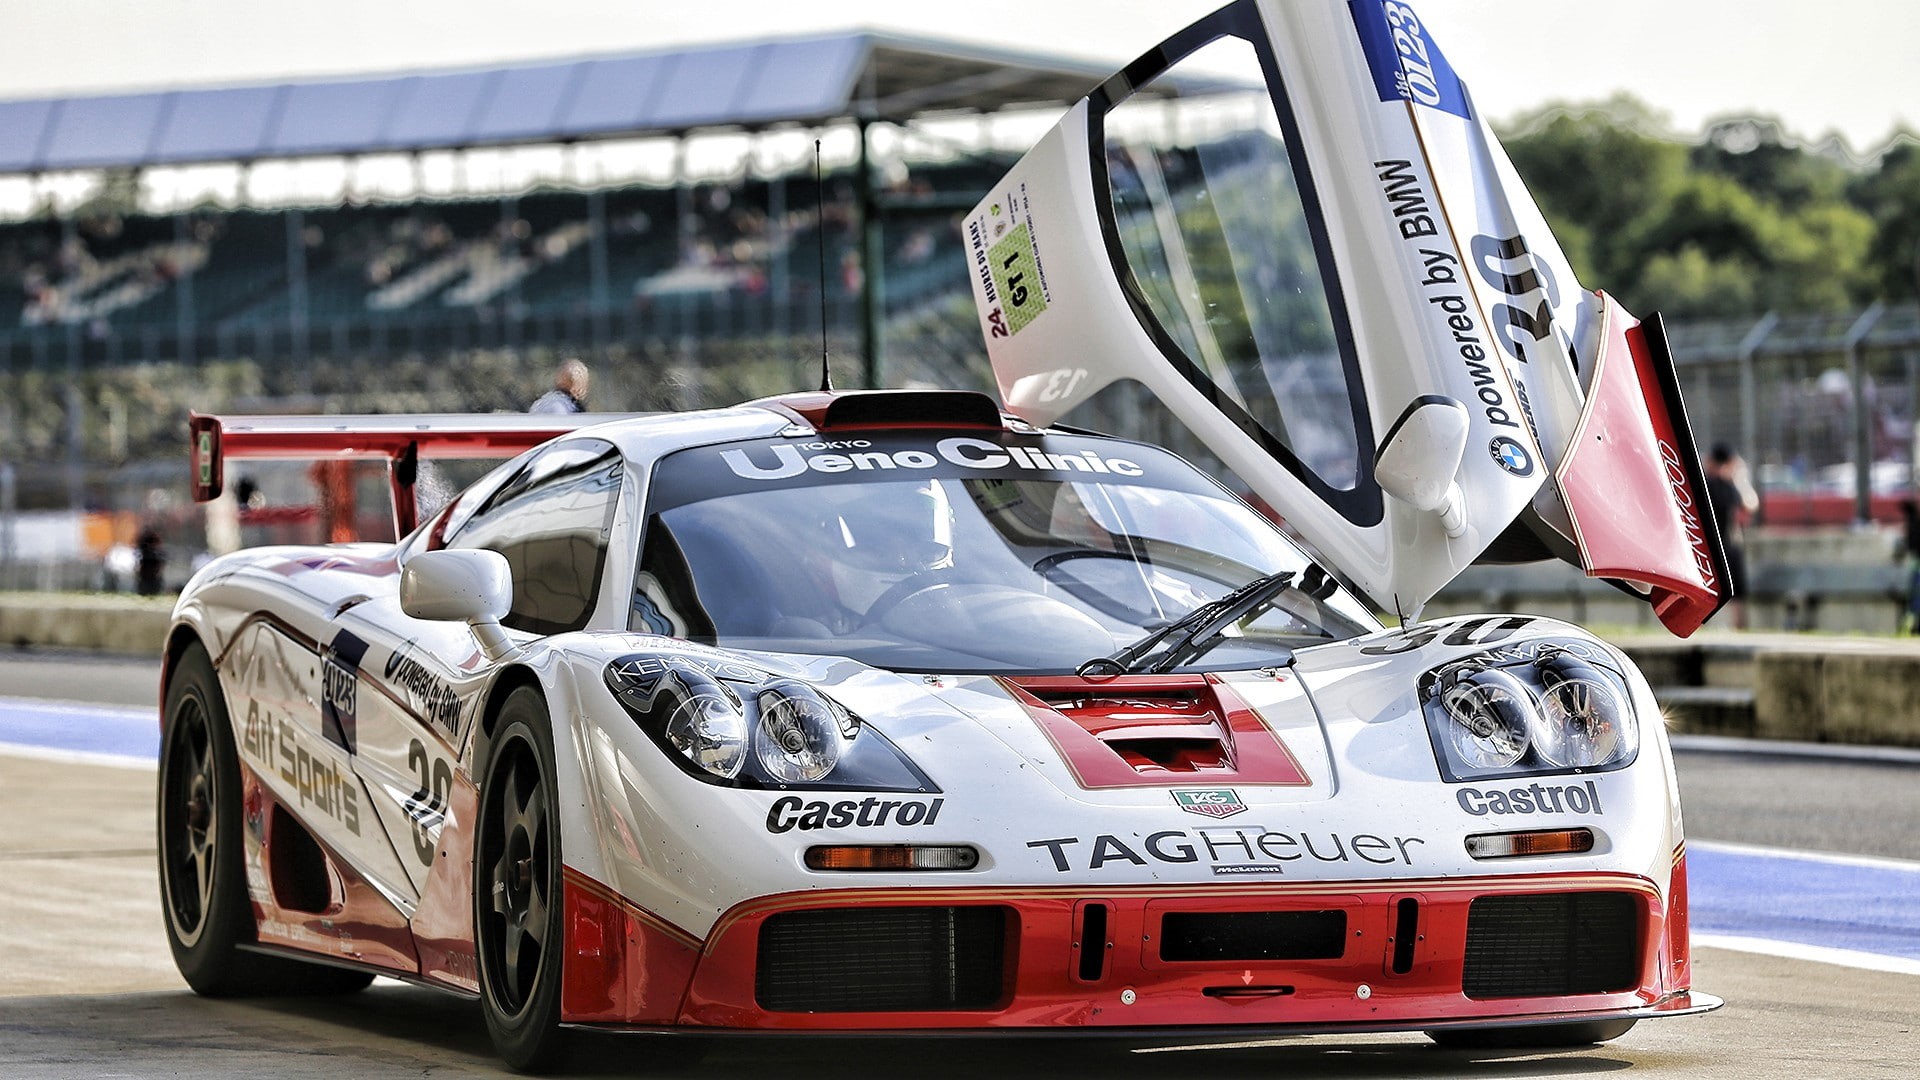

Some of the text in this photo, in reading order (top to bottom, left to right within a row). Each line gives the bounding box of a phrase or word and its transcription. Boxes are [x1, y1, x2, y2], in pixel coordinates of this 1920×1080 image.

[1384, 1, 1440, 107] 0123
[968, 221, 983, 249] MANS
[976, 247, 987, 266] DU
[979, 265, 997, 304] HEURES
[1373, 159, 1519, 428] powered by BMW
[987, 306, 1009, 339] 24
[798, 439, 872, 451] TOKYO
[1658, 439, 1719, 597] KENWOOD
[393, 656, 433, 704] powered
[244, 698, 361, 838] Art Sports
[766, 796, 945, 834] Castrol
[1185, 791, 1227, 804] TAG
[1456, 781, 1604, 816] Castrol
